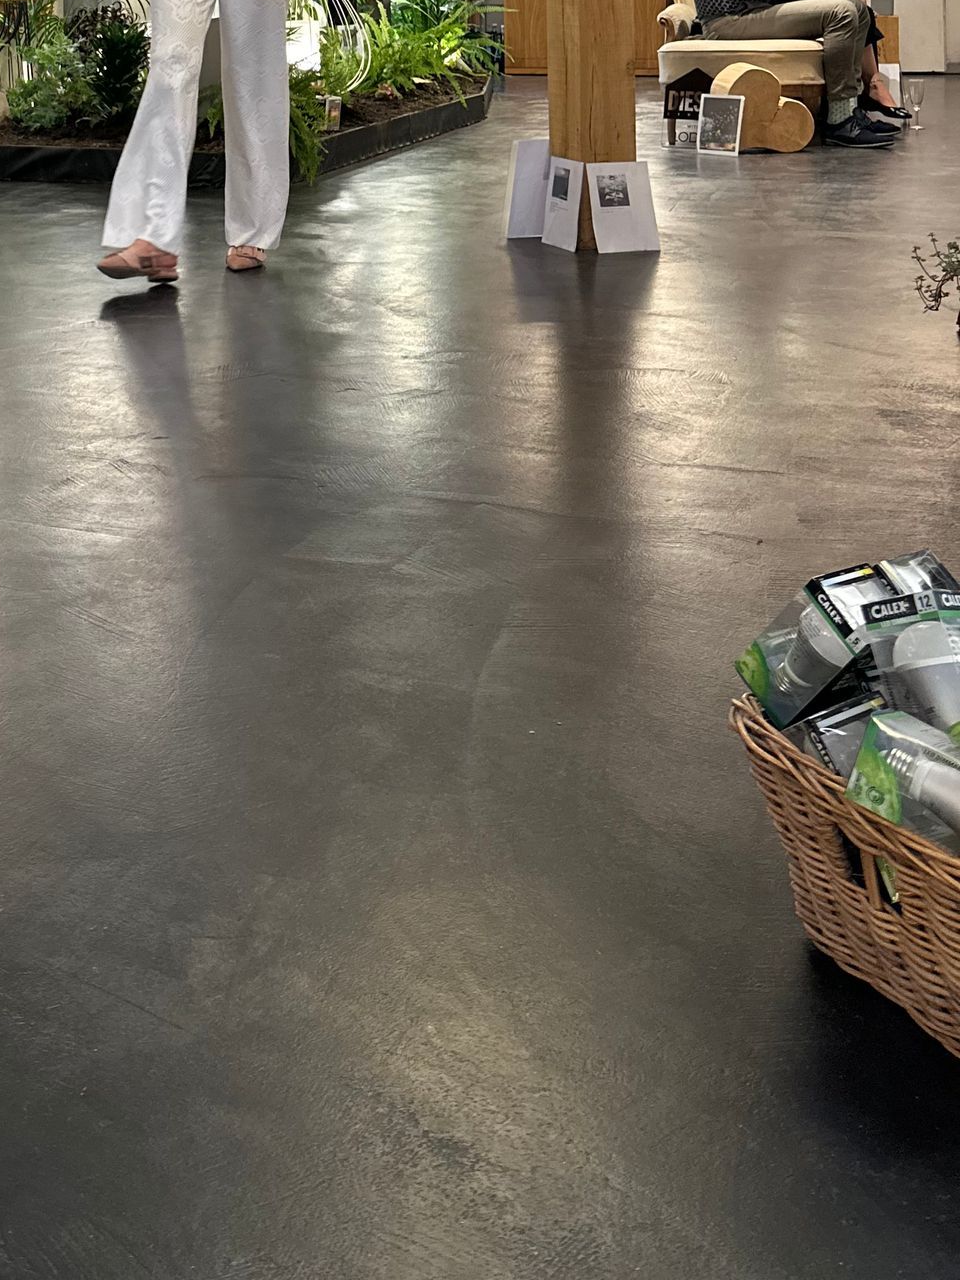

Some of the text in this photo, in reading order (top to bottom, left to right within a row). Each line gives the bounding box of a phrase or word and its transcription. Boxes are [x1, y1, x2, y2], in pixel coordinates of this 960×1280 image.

[817, 593, 842, 625] CALEX
[870, 600, 909, 619] CALEX
[918, 594, 933, 610] 12
